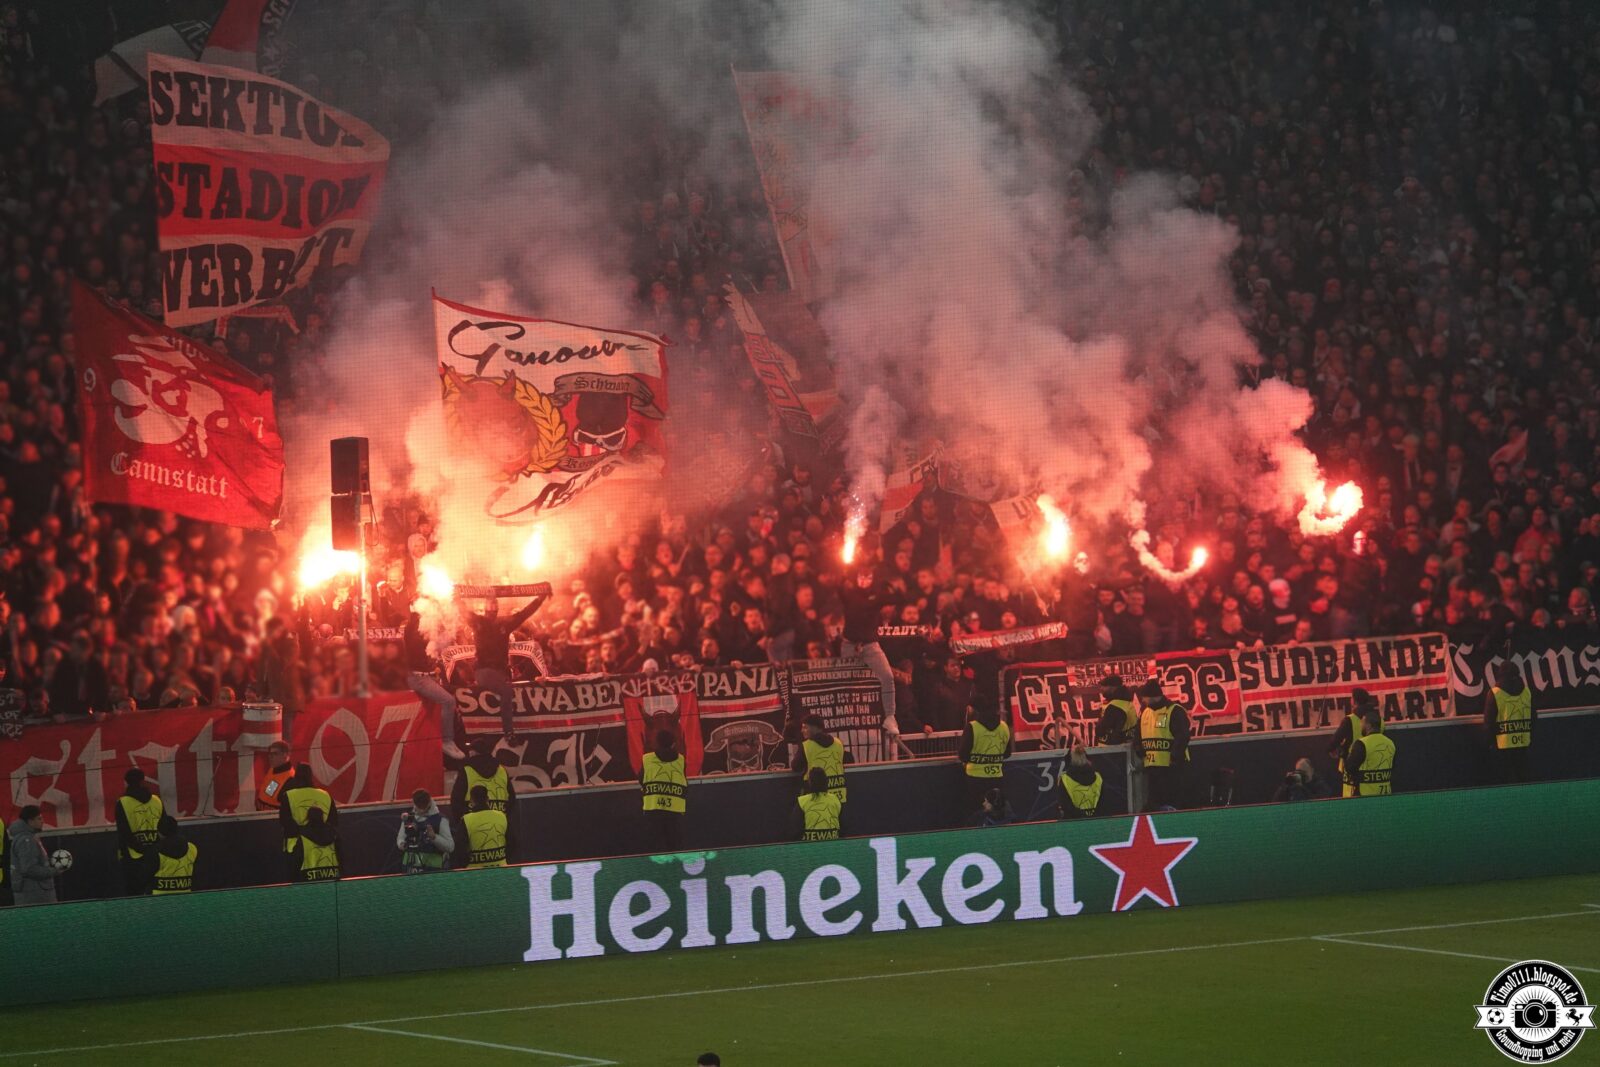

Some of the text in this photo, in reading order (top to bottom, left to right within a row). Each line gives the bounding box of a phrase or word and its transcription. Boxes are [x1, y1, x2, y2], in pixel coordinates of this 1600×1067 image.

[110, 452, 229, 498] Cannstatt
[1073, 659, 1147, 678] SEKTION
[1157, 662, 1228, 713] 36
[1245, 687, 1449, 733] STUTTART
[308, 701, 422, 804] 97
[644, 784, 683, 796] STEWARD
[470, 850, 507, 863] STEWAR
[801, 831, 840, 841] STEWAR
[521, 837, 1083, 962] Heineken
